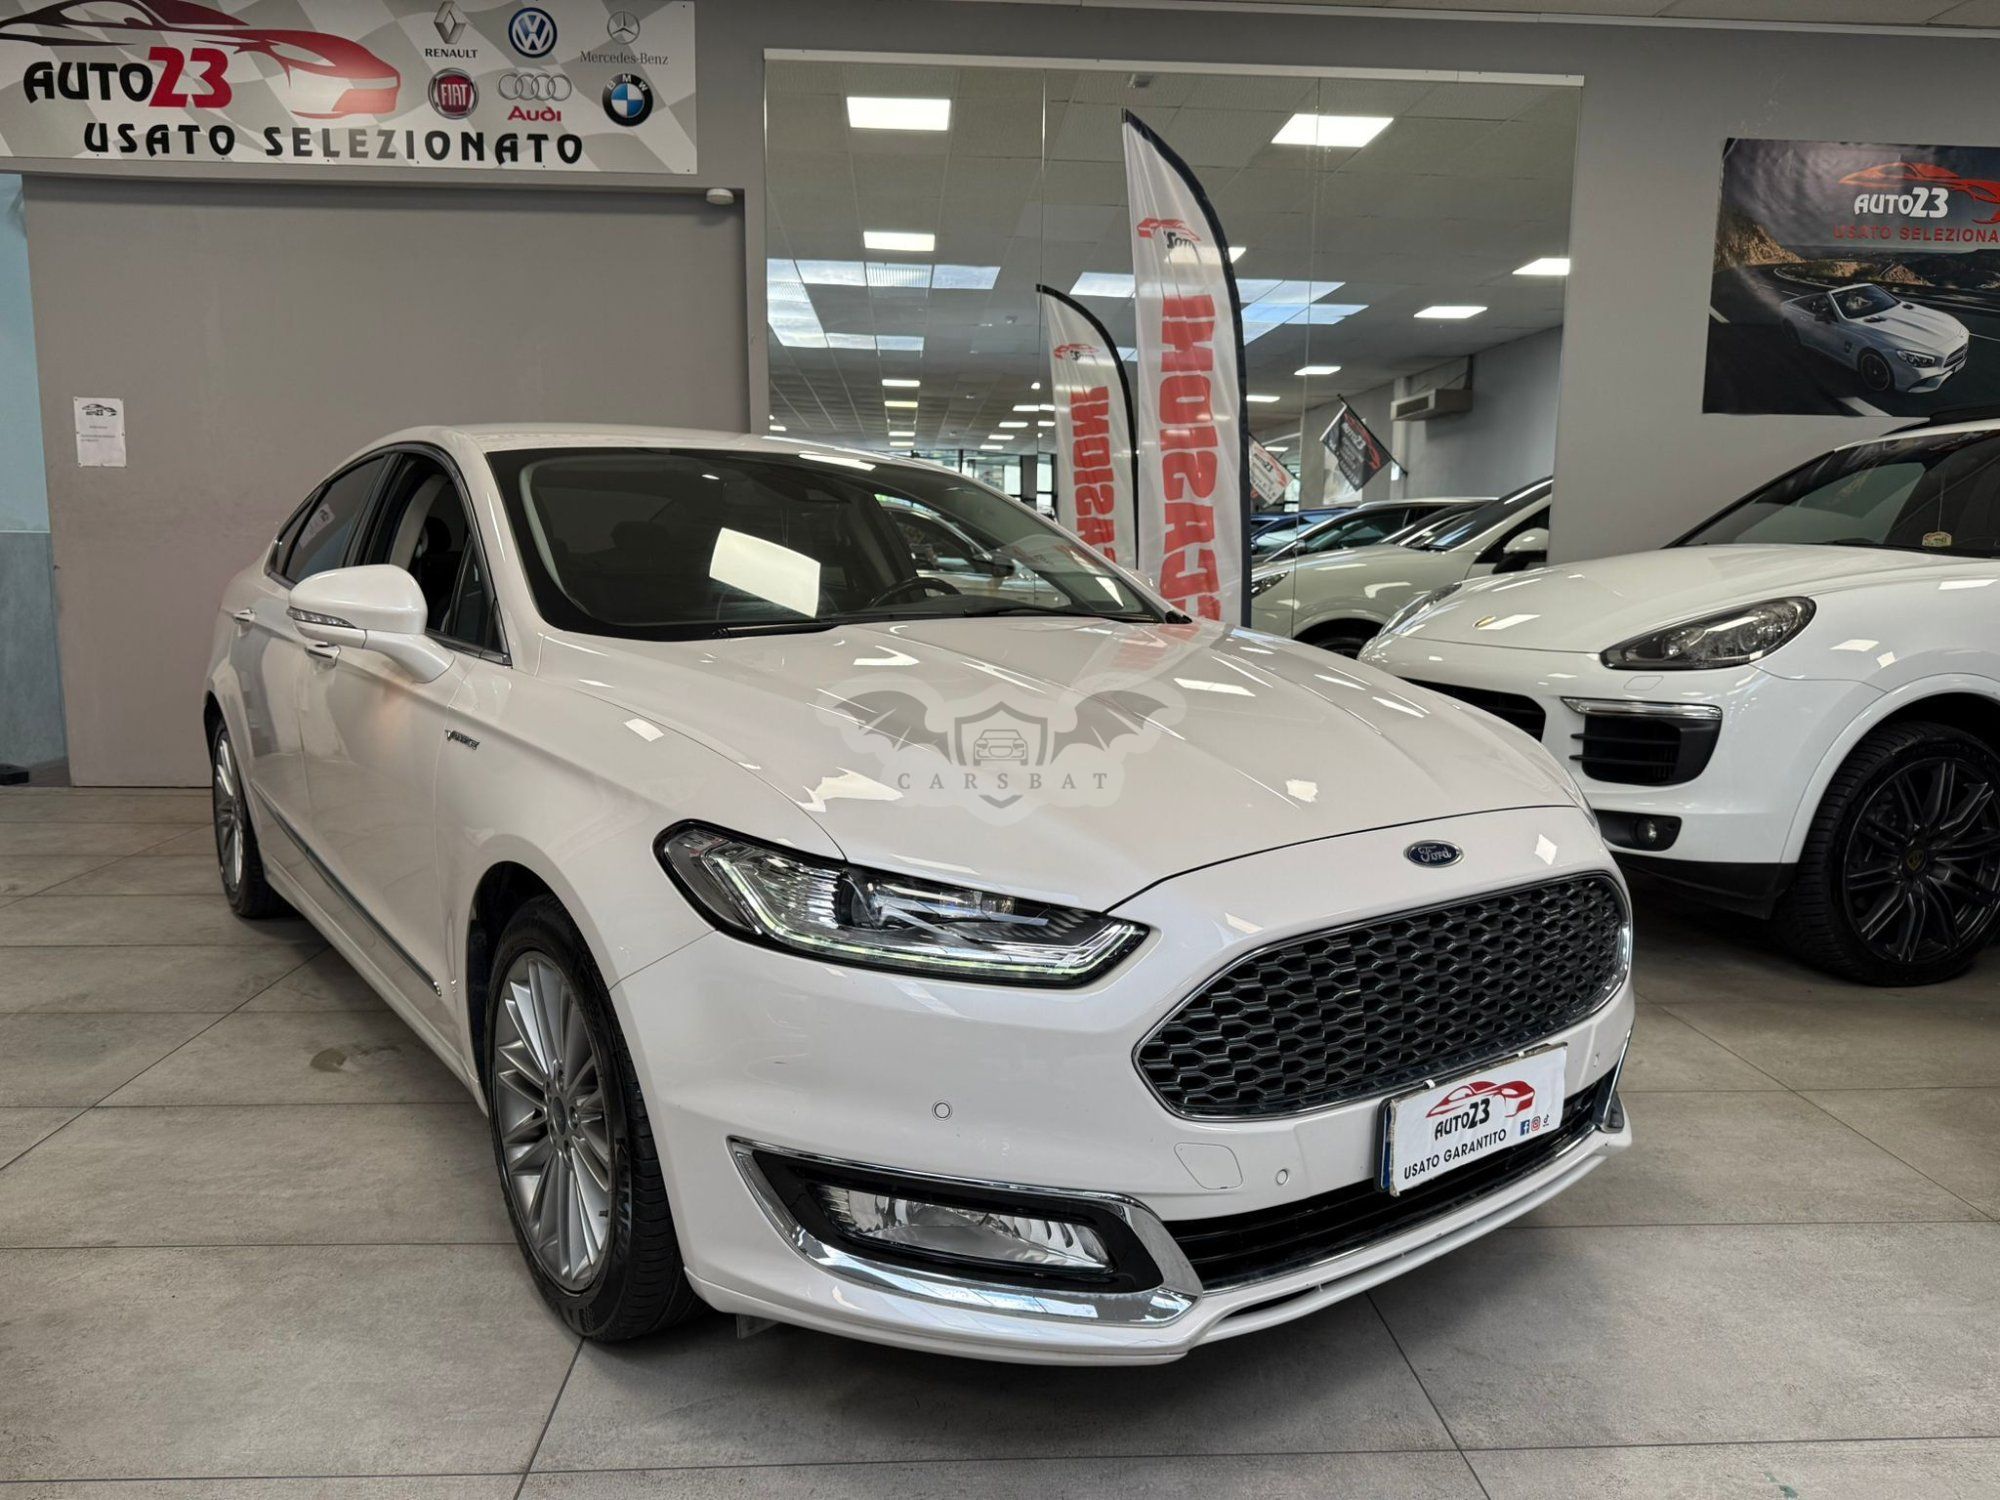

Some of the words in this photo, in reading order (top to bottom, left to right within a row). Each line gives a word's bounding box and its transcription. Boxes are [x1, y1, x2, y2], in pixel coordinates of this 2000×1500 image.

[425, 48, 478, 59] RENAULT
[579, 50, 669, 66] Mercedes-Benz
[23, 46, 233, 109] AUTO23
[440, 82, 468, 106] FIAT
[507, 105, 562, 122] Audi
[84, 122, 235, 158] USATO
[264, 126, 583, 165] SELEZIONATO
[1853, 186, 1949, 218] AUTO23
[1833, 224, 1892, 240] USATO
[1899, 226, 2000, 243] SELEZIONA
[1417, 845, 1452, 863] Ford
[1434, 1098, 1490, 1141] AUTO23
[1403, 1154, 1440, 1180] USATO
[1443, 1128, 1507, 1162] GARANTITO
